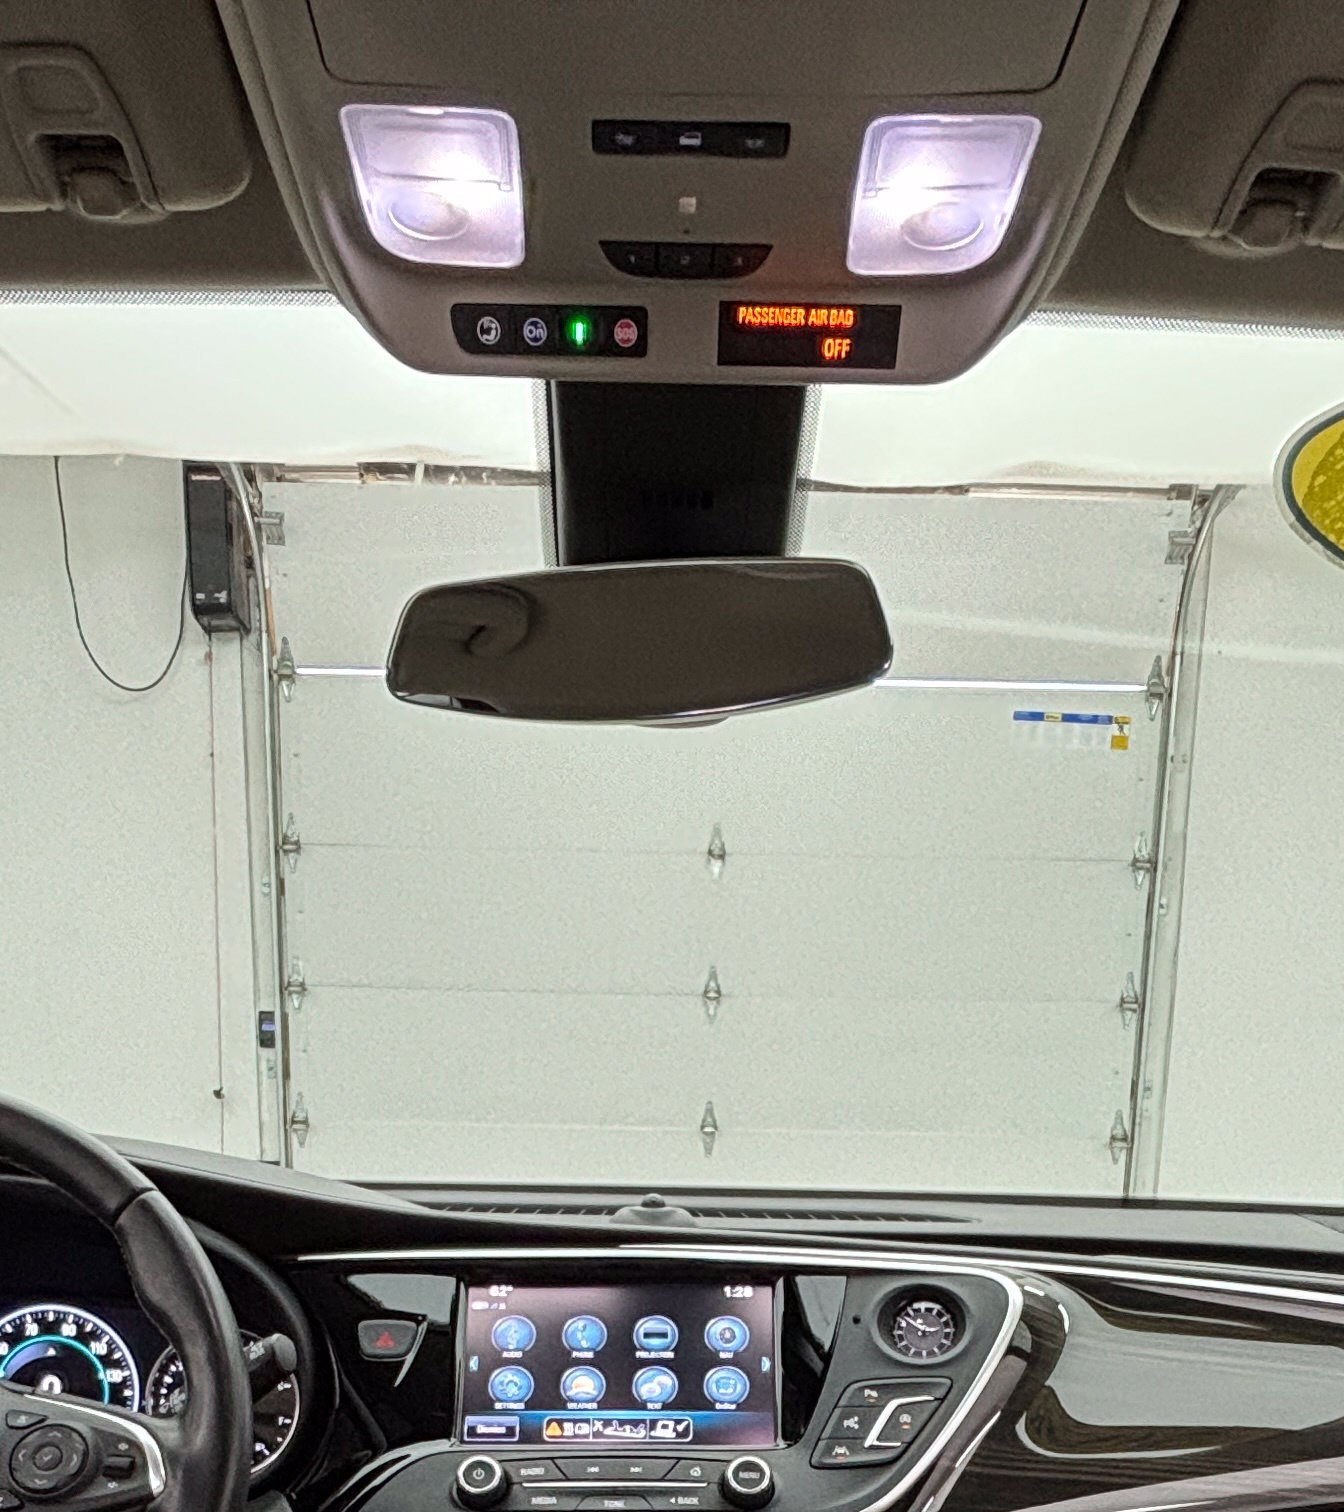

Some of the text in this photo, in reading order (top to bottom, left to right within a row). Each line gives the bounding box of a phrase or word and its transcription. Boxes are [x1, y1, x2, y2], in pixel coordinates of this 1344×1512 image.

[737, 306, 854, 328] PASSENGER AIR BAG
[526, 326, 544, 339] On
[615, 327, 637, 339] SOS
[823, 338, 852, 359] OFF
